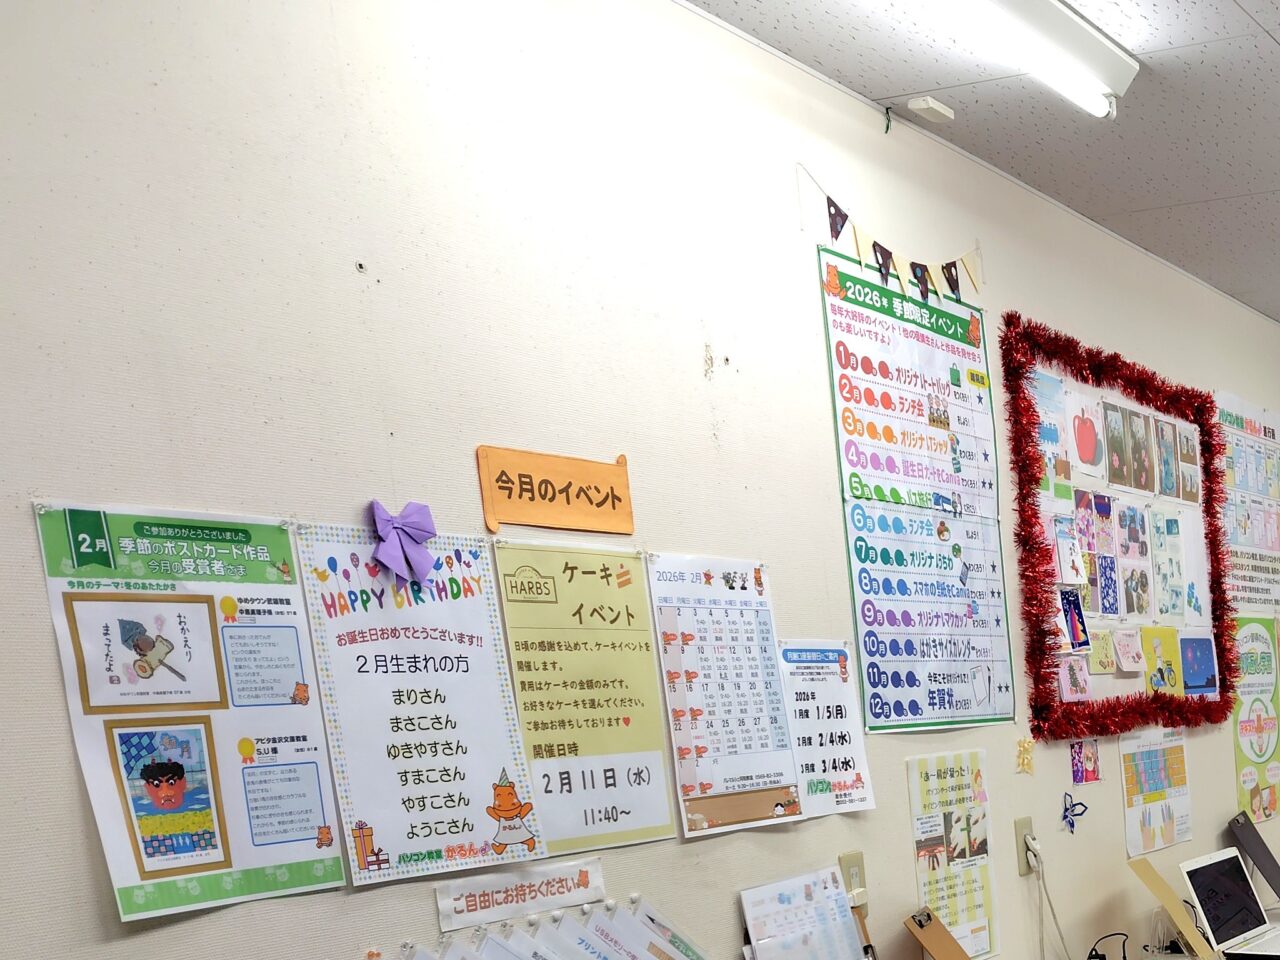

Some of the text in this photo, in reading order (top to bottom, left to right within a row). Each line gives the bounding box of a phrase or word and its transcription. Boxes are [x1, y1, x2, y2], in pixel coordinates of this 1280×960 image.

[846, 281, 963, 338] 2026年 季節限定イベント
[898, 396, 925, 418] ランチ会
[495, 469, 623, 511] 今月のイベント
[854, 507, 934, 537] 6月 ランチ会
[77, 532, 109, 554] 2月
[143, 525, 246, 542] ご参加ありがとうございました
[118, 537, 271, 562] 季節のポストカード作品
[856, 540, 877, 562] 7月
[148, 558, 247, 577] 今月の受賞者さま
[562, 561, 613, 587] ケーキ
[509, 579, 551, 597] HARBS
[861, 574, 879, 594] 8月
[321, 586, 385, 619] HAPPY
[571, 602, 635, 627] イベント
[864, 604, 884, 625] 9月
[102, 622, 114, 673] まってたよ
[176, 612, 193, 663] おかえり
[335, 626, 484, 648] お誕生日おめでとうございます!!
[514, 639, 651, 653] 日頃の感謝を込めて、ケーキイベントを
[865, 635, 886, 656] 10月
[355, 653, 470, 675] 2月生まれの方
[516, 660, 564, 673] 開催します。
[519, 678, 630, 693] 費用はケーキの金額のみです。
[868, 667, 887, 687] 11月
[391, 688, 447, 706] まりさん
[522, 697, 646, 712] お好きなケーキを選んでください。
[870, 687, 955, 718] 12月 年賀状
[815, 704, 848, 721] 1/5(月)
[389, 714, 457, 733] まさこさん
[818, 730, 852, 748] 2/4(水)
[386, 740, 468, 761] ゆきやすさん
[532, 741, 580, 760] 開催日時
[821, 756, 856, 774] 3/4(水)
[396, 766, 466, 787] すまこさん
[401, 792, 470, 813] やすこさん
[406, 818, 474, 840] ようこさん
[398, 848, 444, 866] パソコン教室
[452, 876, 578, 915] ご自由にお持ちください
